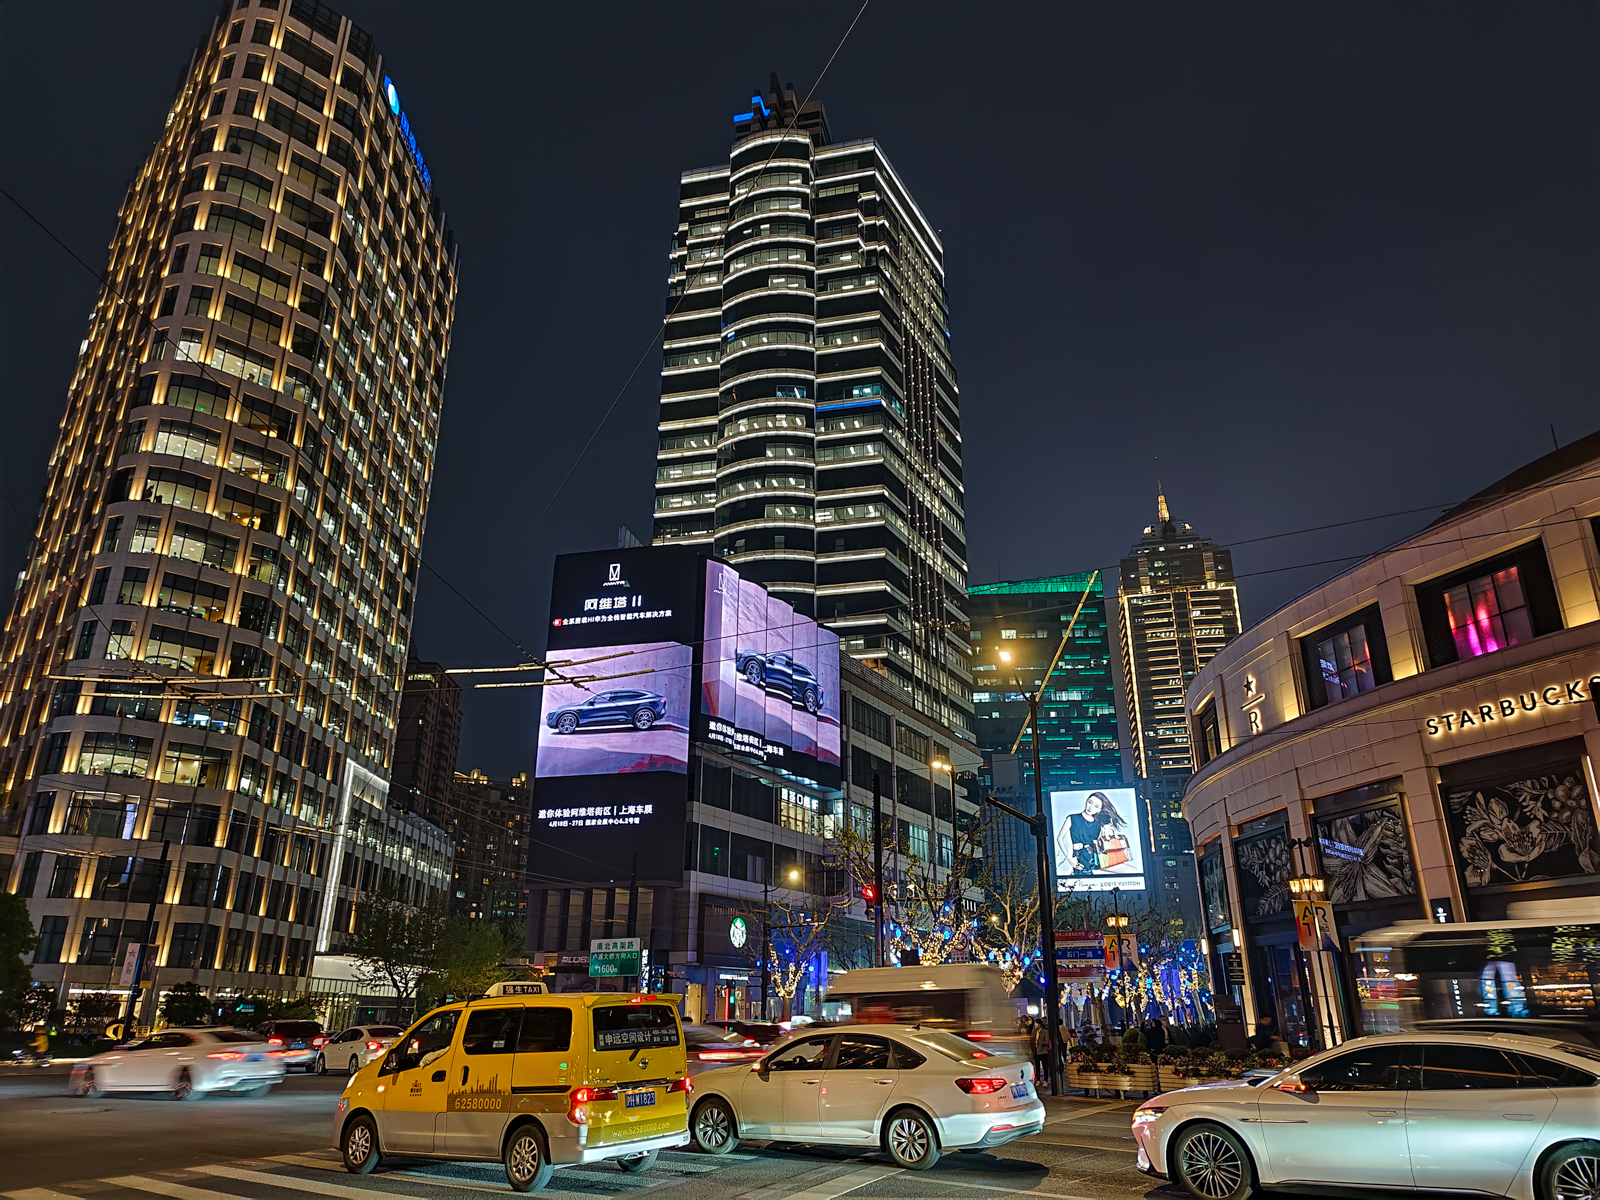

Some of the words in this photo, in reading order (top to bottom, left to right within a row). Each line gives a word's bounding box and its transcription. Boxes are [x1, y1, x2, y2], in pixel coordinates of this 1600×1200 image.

[584, 596, 627, 611] 阿维塔
[1248, 711, 1260, 732] R
[538, 806, 612, 819] 邀你体验阿维塔街区
[618, 804, 653, 815] 上海车展
[596, 941, 634, 950] 南北高架路
[592, 952, 638, 960] 卢浦大桥方向入口
[605, 1030, 652, 1046] 申远空间设计
[455, 1098, 502, 1109] 62580000
